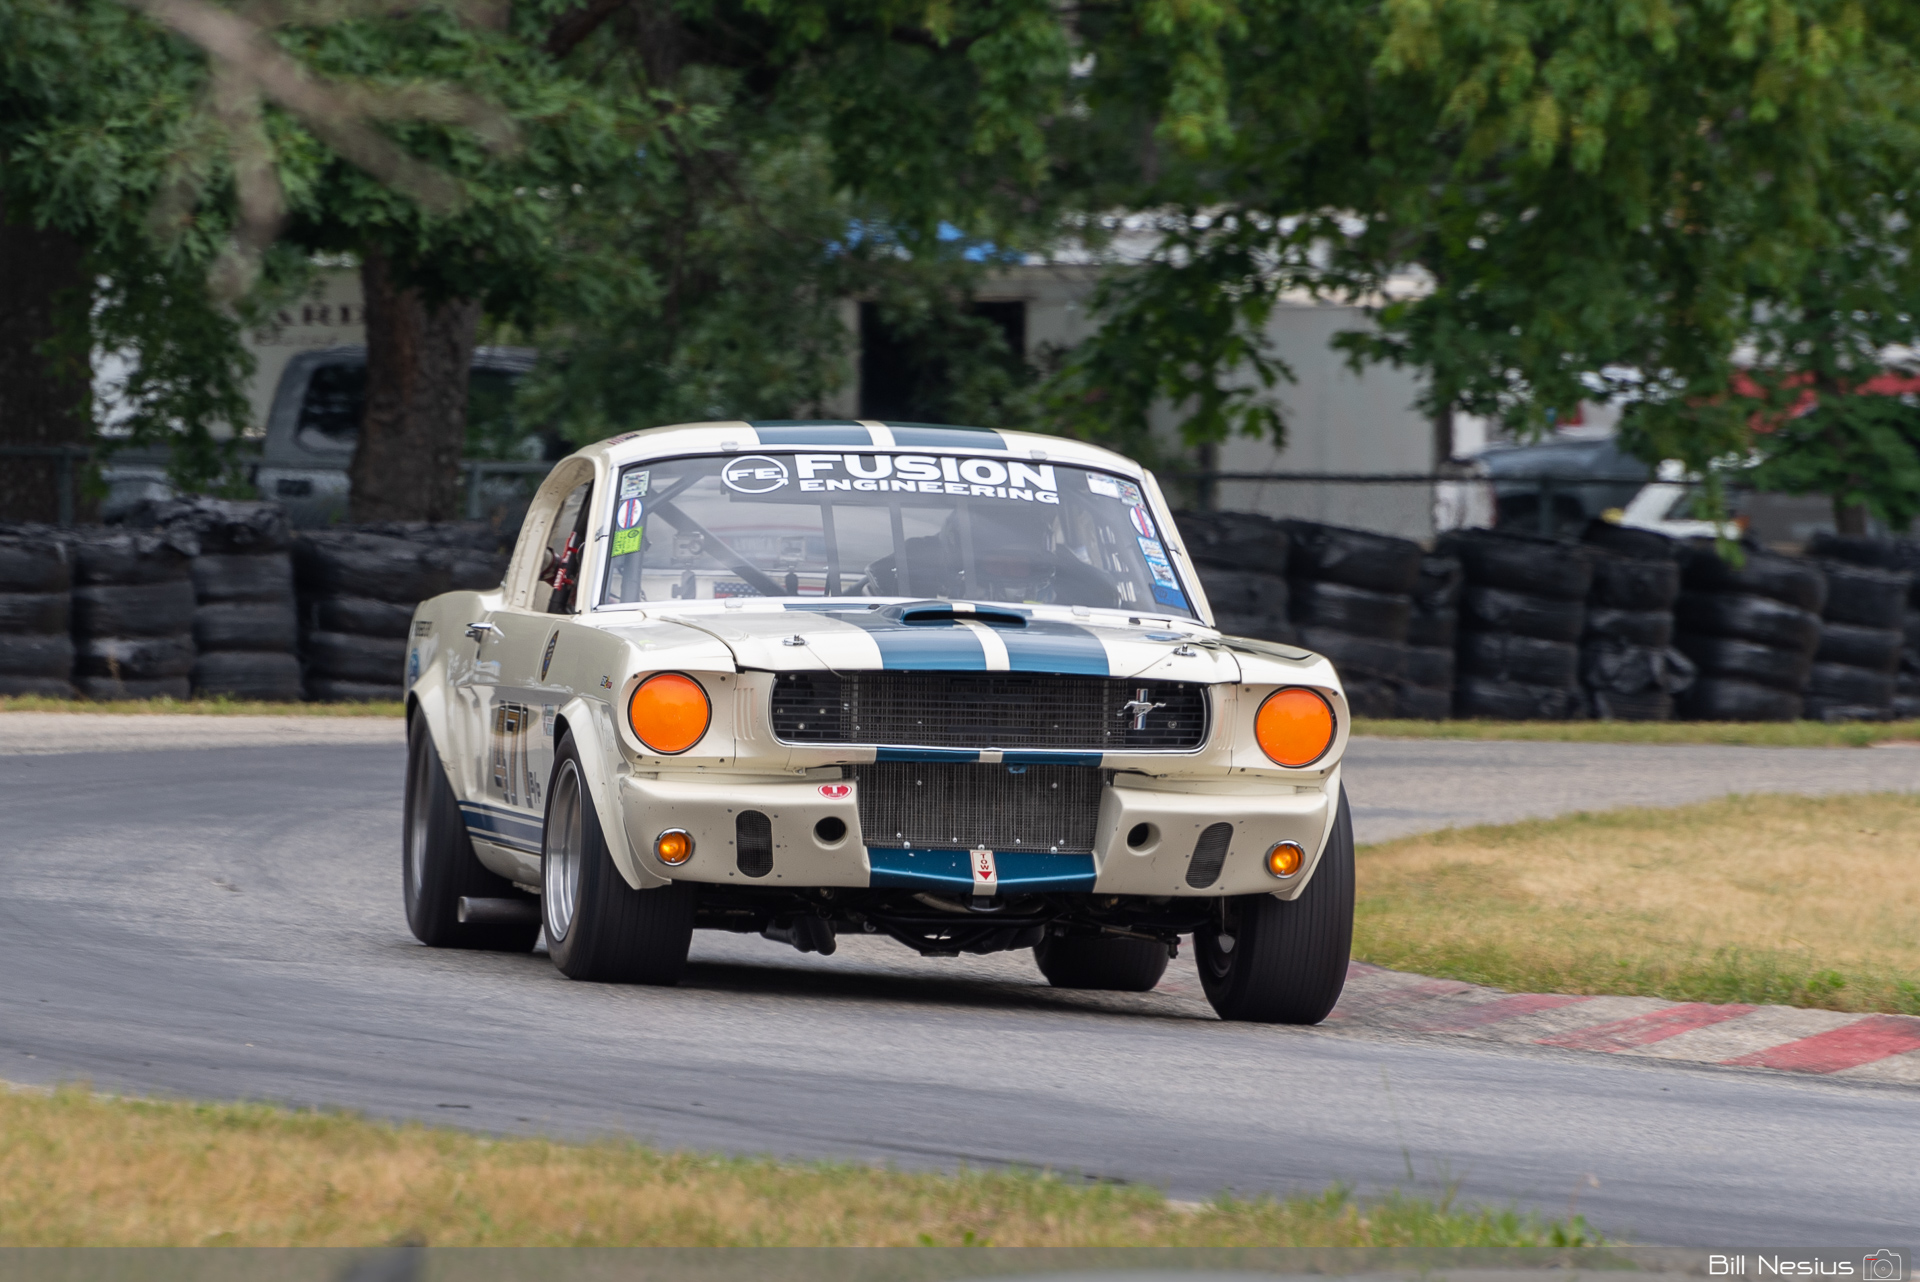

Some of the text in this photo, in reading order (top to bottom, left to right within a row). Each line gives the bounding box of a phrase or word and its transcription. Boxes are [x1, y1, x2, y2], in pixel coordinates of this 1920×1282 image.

[727, 468, 781, 481] FE
[794, 454, 1058, 492] FUSION
[799, 479, 1060, 505] ENGINEERING
[980, 853, 990, 870] TOW
